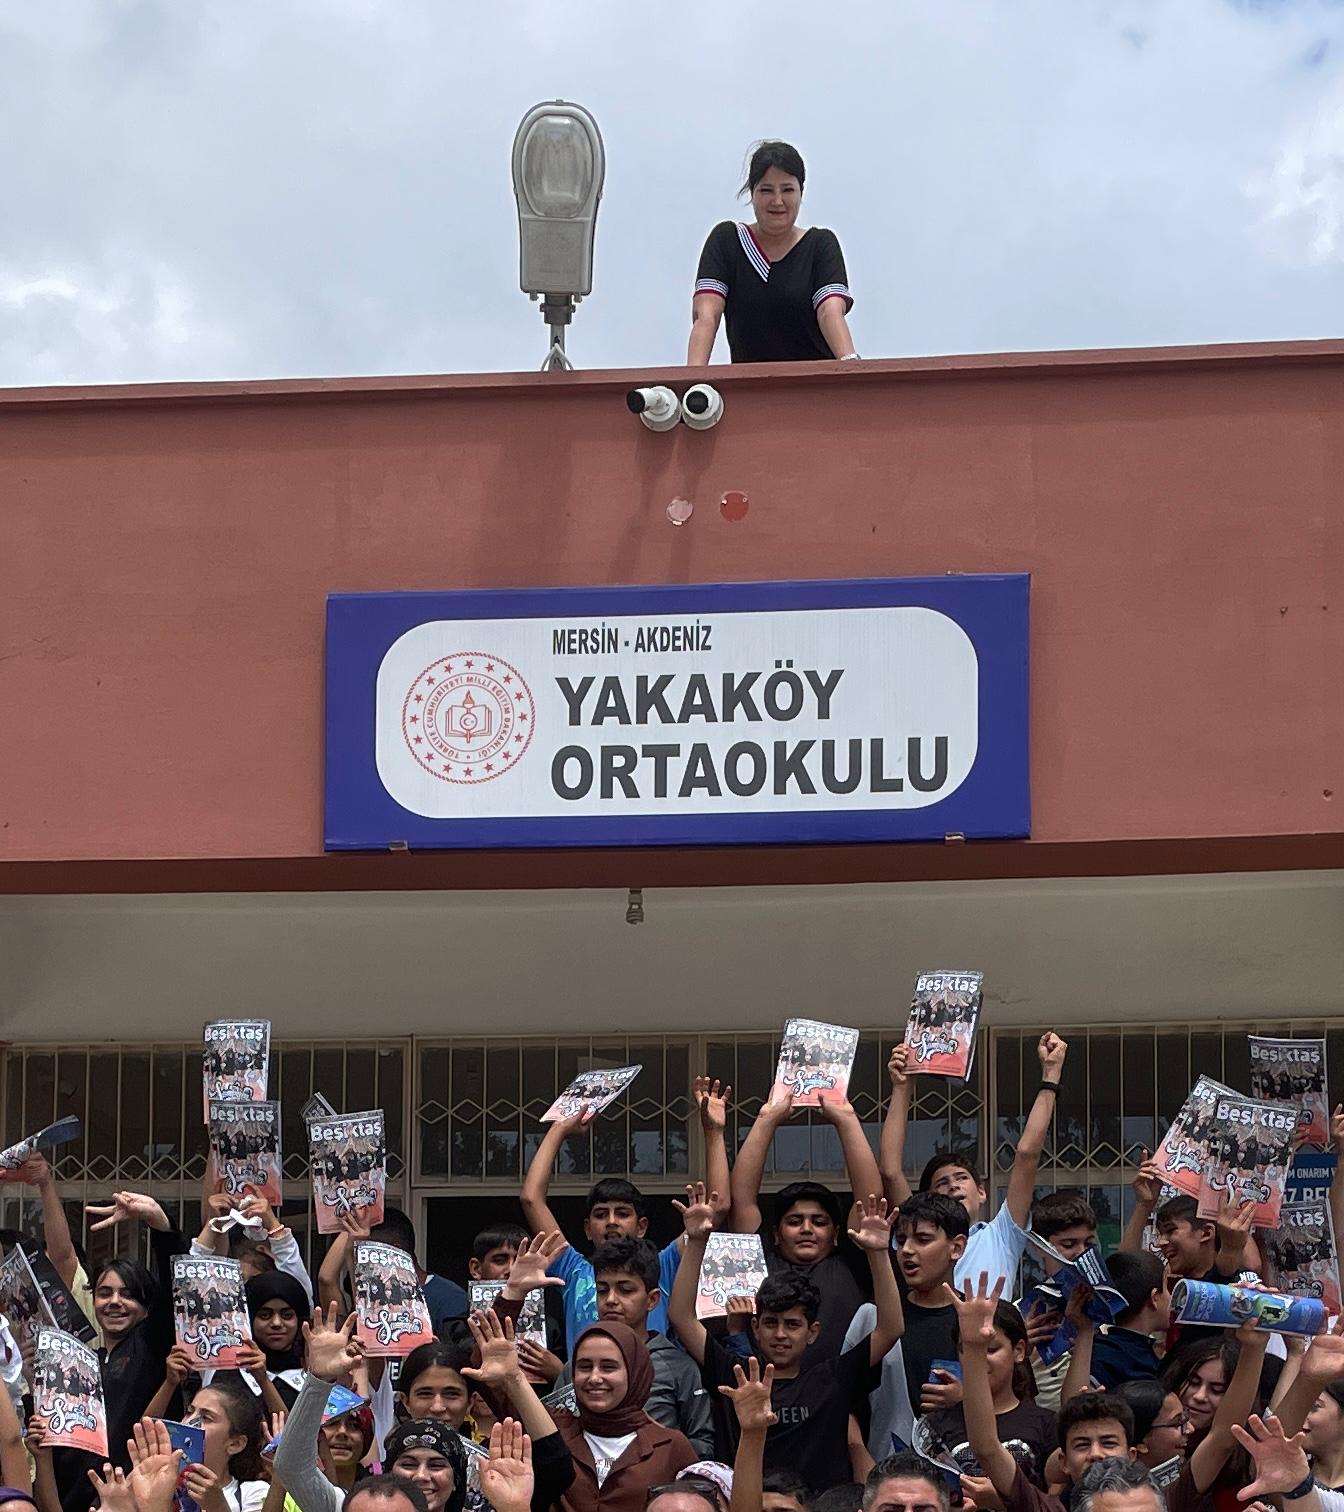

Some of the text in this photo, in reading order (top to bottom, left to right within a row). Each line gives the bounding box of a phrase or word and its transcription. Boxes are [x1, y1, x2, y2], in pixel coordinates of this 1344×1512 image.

[552, 621, 619, 656] MERSİN
[634, 619, 713, 653] AKDENİZ
[556, 660, 845, 727] YAKAKÖY
[550, 736, 950, 801] ORTAOKULU
[1296, 1167, 1330, 1179] ONARIM
